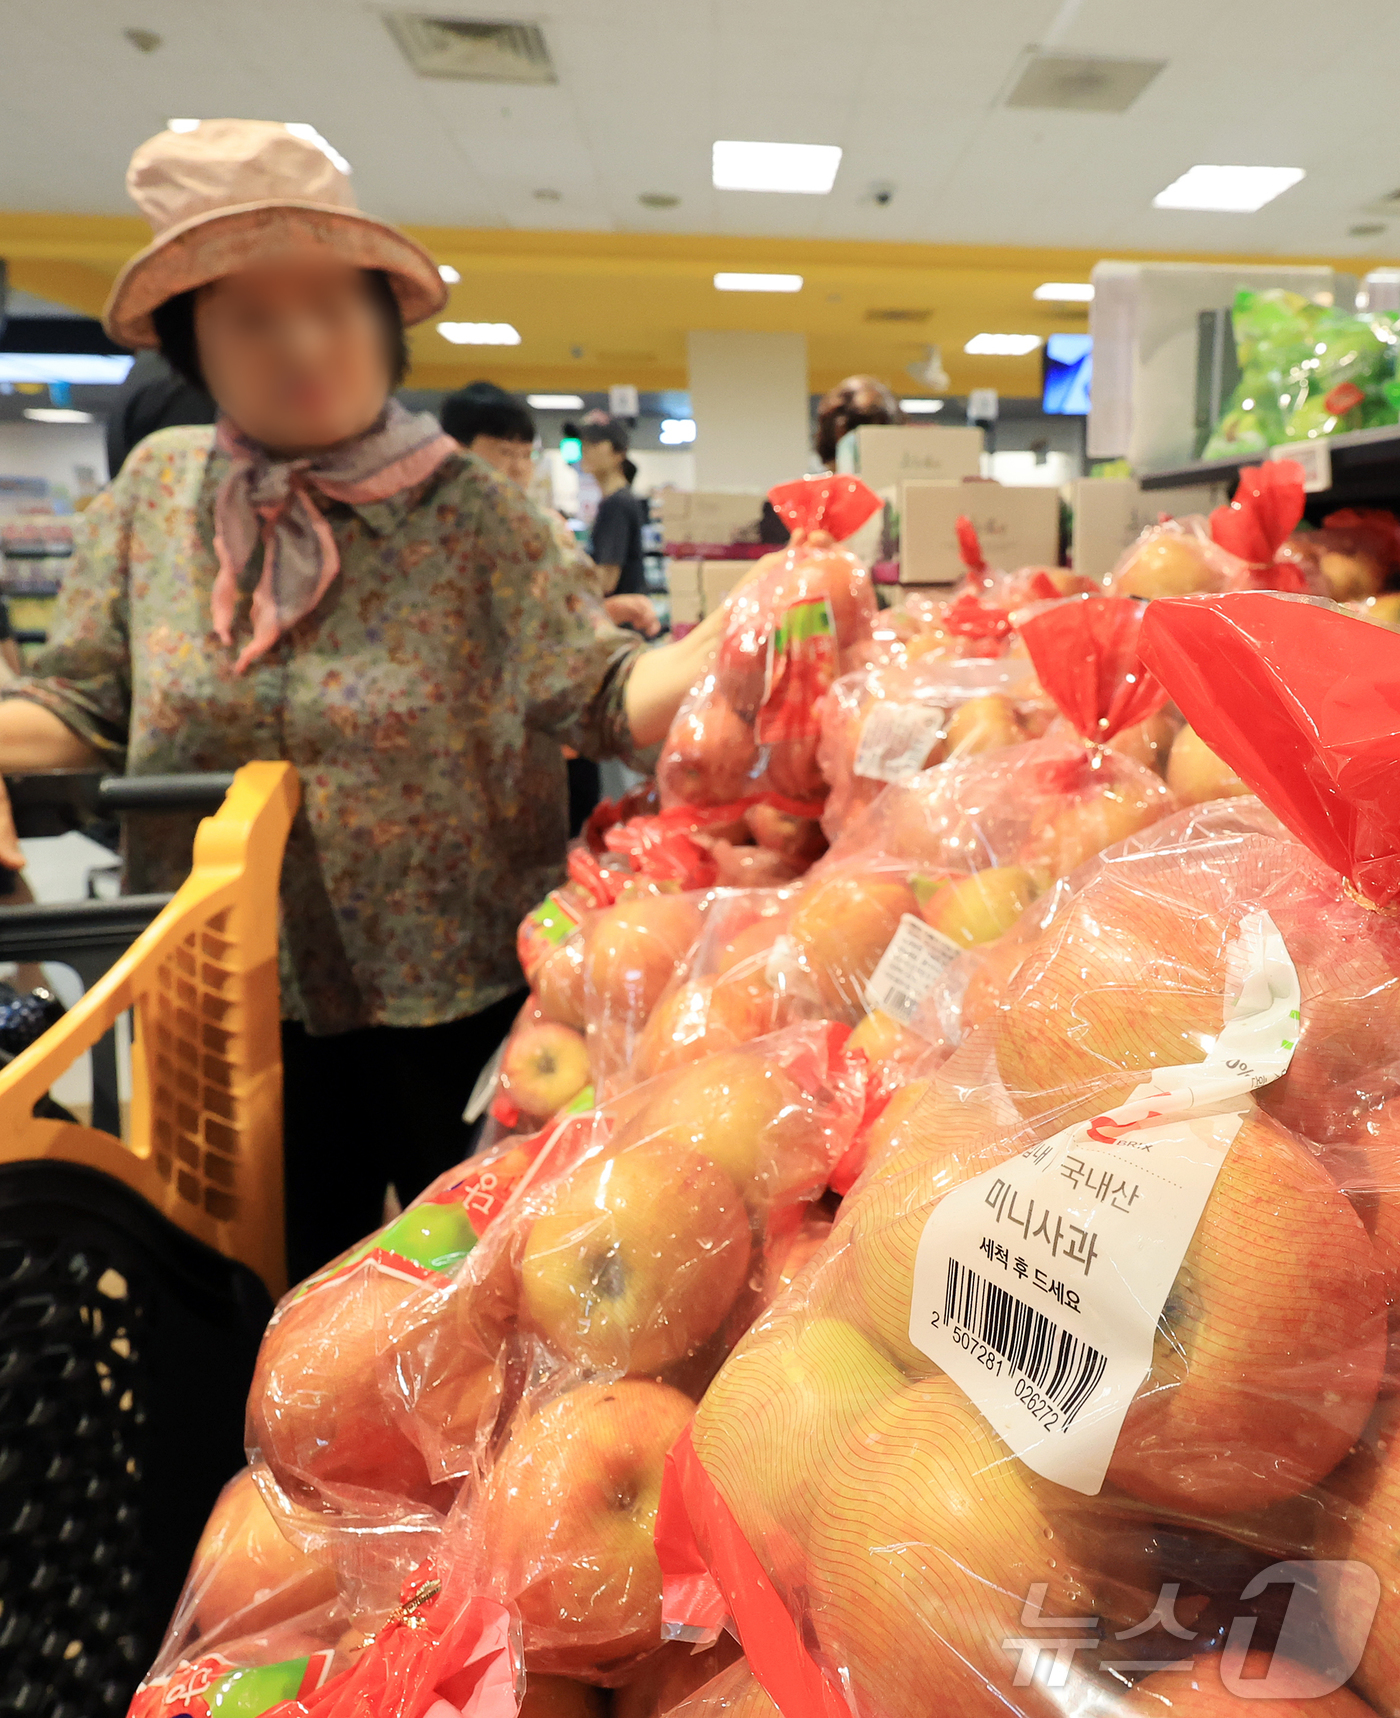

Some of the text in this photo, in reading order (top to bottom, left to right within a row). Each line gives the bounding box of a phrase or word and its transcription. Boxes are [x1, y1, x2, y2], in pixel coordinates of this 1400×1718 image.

[983, 1178, 1099, 1276] 미니사과
[1060, 1155, 1140, 1214] 국내산
[979, 1236, 1082, 1315] 세척 후 드세요
[930, 1310, 1060, 1433] 2 507281 026272
